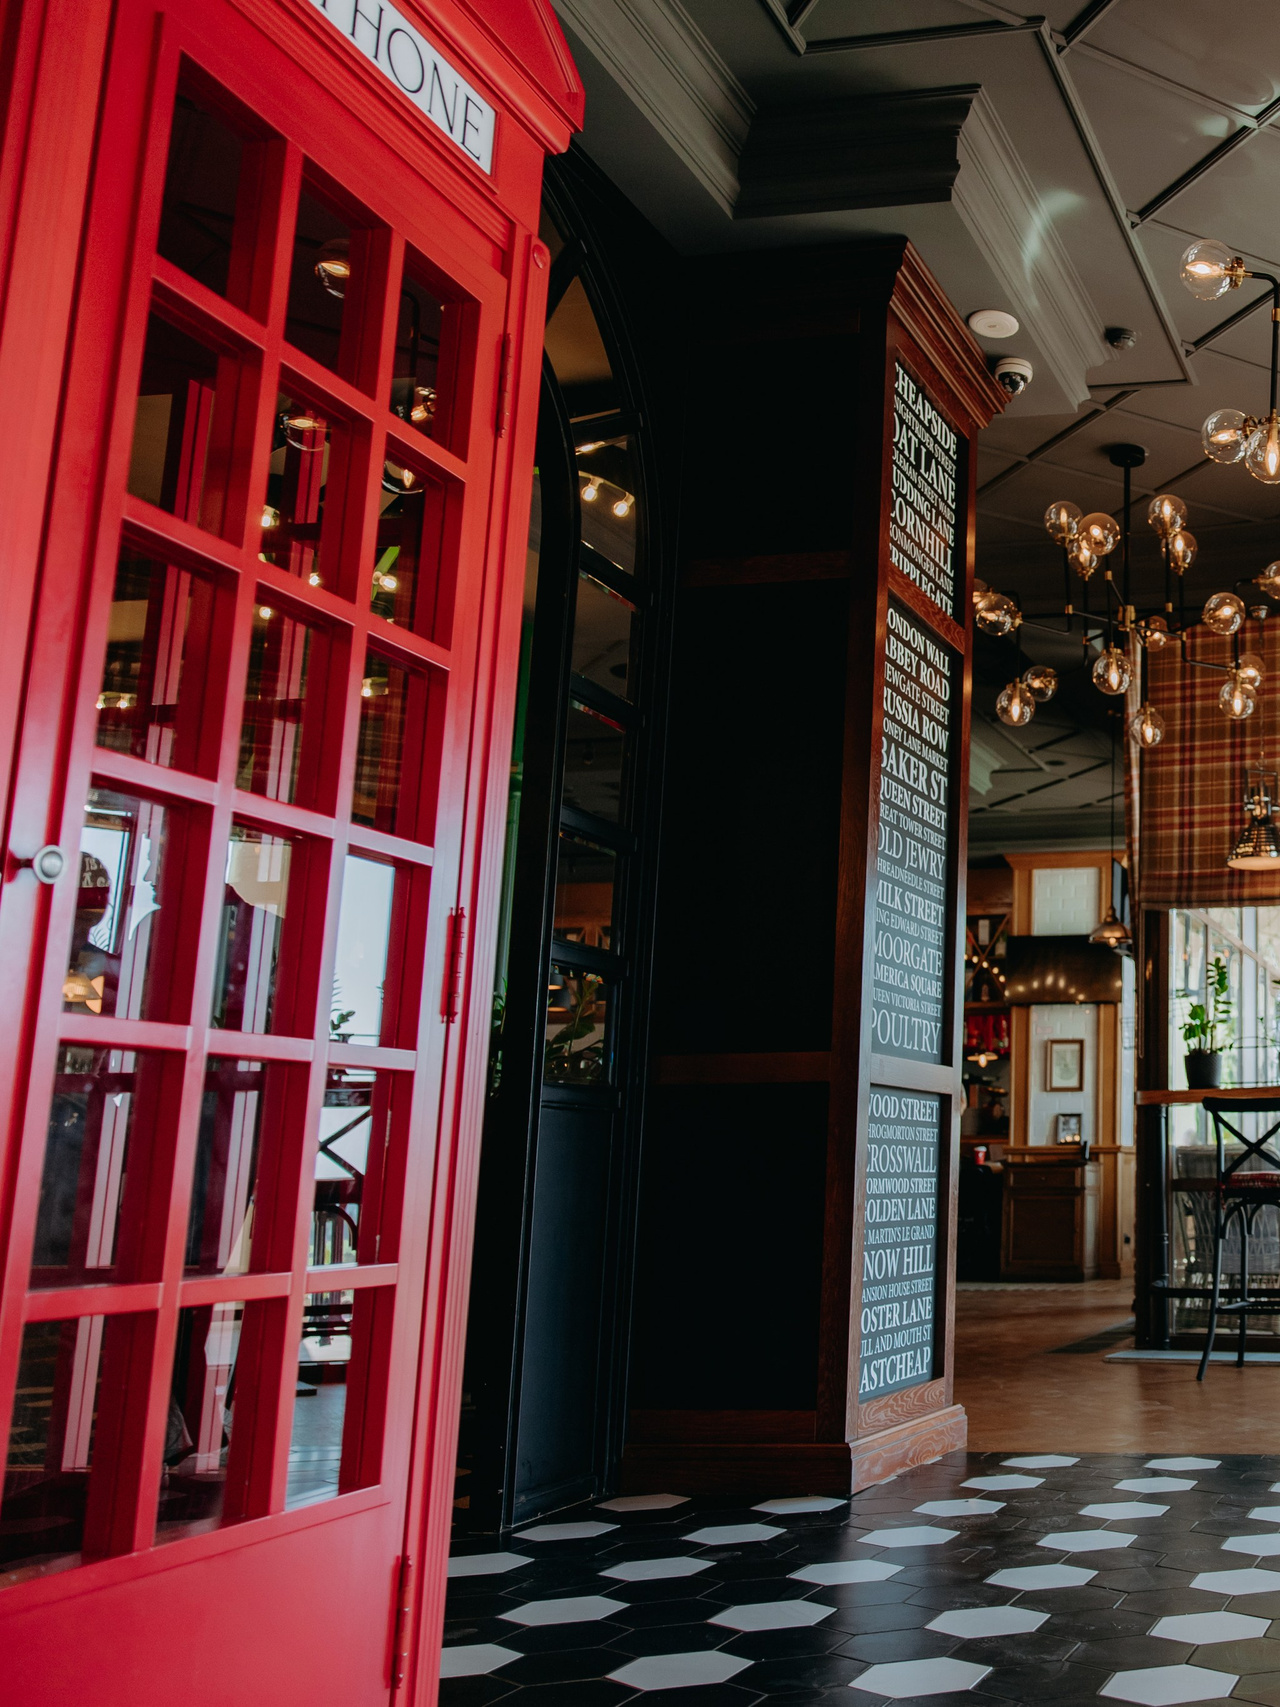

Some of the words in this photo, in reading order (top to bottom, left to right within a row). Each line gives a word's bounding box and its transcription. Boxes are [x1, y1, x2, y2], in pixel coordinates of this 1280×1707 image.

[319, 0, 484, 161] HONE
[893, 394, 935, 454] NIGHTRIDER
[934, 443, 957, 478] STREET
[892, 446, 918, 483] LEMAN
[917, 475, 939, 506] STREET
[938, 498, 956, 525] WARD
[919, 445, 956, 509] LANE
[892, 464, 931, 521] UDDING
[931, 508, 955, 547] LANE
[889, 521, 936, 579] ONMONGER
[934, 564, 954, 597] LANE
[889, 543, 953, 619] RIPPLEGATE
[886, 608, 925, 655] ONDON
[925, 639, 950, 677] WALL
[919, 660, 950, 701] ROAD
[921, 691, 950, 725] STREET
[882, 717, 904, 742] ONEY
[903, 727, 922, 754] LANE
[921, 744, 949, 773] MARKET
[921, 714, 949, 753] ROW
[930, 770, 948, 806] ST
[879, 802, 899, 824] REAT
[898, 812, 924, 840] TOWER
[923, 826, 946, 851] STREET
[911, 794, 947, 831] STREET
[904, 837, 946, 881] JEWRY
[877, 857, 923, 891] HREADNEEDLE
[923, 880, 945, 900] STREET
[875, 908, 890, 926] ING
[890, 913, 920, 937] EDWARD
[919, 925, 944, 946] STREET
[903, 891, 945, 928] STREET
[873, 963, 910, 990] MERICA
[910, 973, 942, 999] SQUARE
[873, 988, 891, 1005] UEEN
[890, 993, 920, 1013] VICTORIA
[919, 1000, 942, 1018] STREET
[900, 1097, 939, 1122] STREET
[868, 1123, 915, 1141] HROGMORTON
[915, 1128, 938, 1143] STREET
[866, 1178, 910, 1194] ORMWOOD
[909, 1177, 936, 1194] STREET
[864, 1198, 907, 1223] OLDEN
[907, 1197, 936, 1220] LANE
[902, 1226, 911, 1242] LE
[910, 1224, 935, 1241] GRAND
[863, 1248, 901, 1281] NOW
[902, 1244, 934, 1276] HILL
[862, 1285, 888, 1303] ANSION
[888, 1281, 911, 1299] HOUSE
[910, 1277, 934, 1294] STREET
[861, 1302, 900, 1334] OSTER
[901, 1296, 933, 1326] LANE
[859, 1337, 874, 1359] ULL
[874, 1333, 893, 1354] AND
[893, 1326, 922, 1350] MOUTH
[922, 1324, 932, 1342] ST
[859, 1346, 931, 1394] ASTCHEAP
